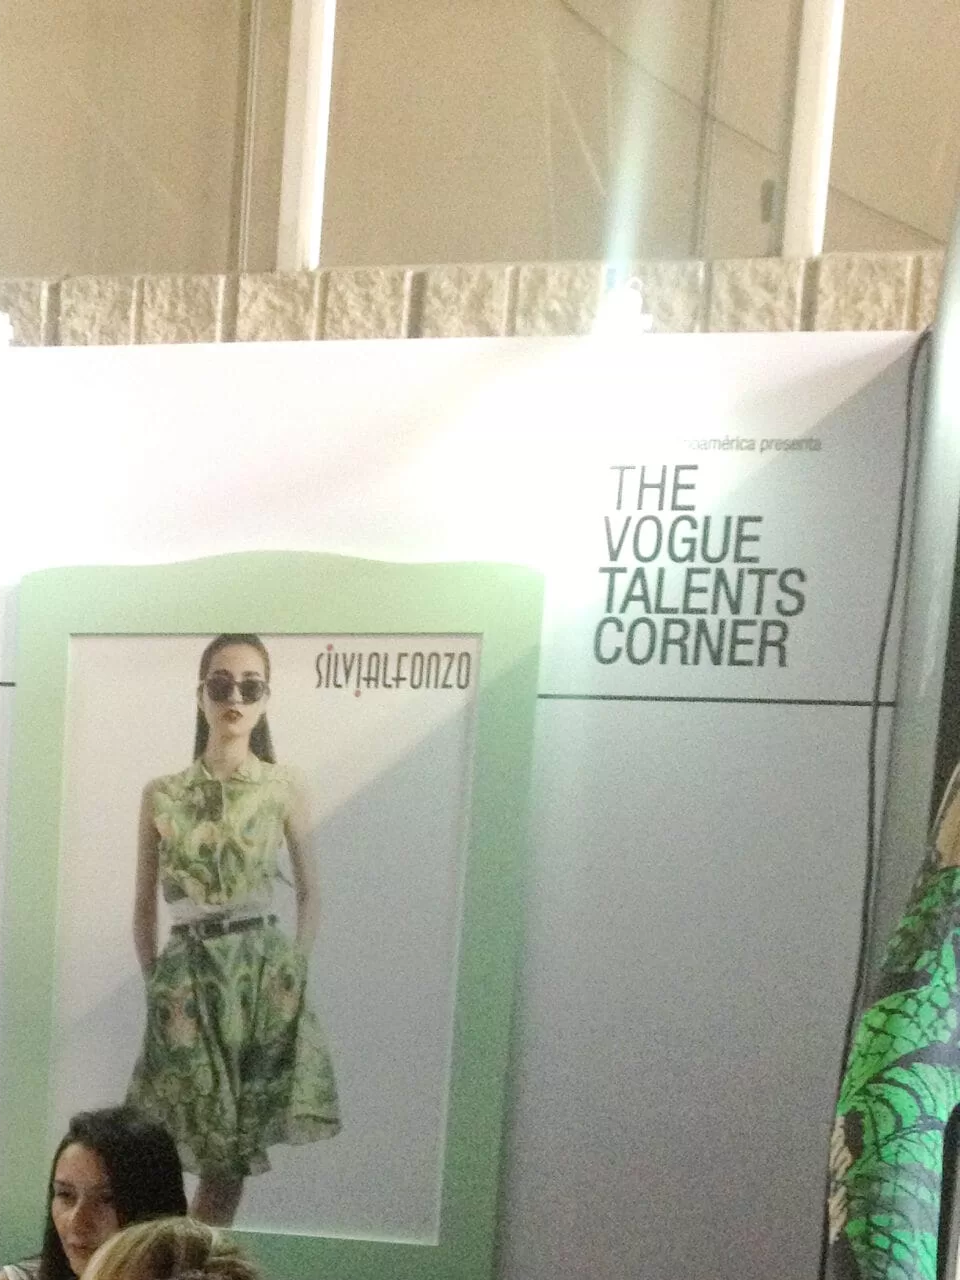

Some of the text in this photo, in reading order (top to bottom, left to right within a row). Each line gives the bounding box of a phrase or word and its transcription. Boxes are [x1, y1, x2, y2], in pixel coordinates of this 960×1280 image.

[609, 464, 699, 511] THE
[603, 514, 763, 564] VOGUE
[598, 566, 807, 617] TALENTS
[594, 616, 790, 668] CORNER
